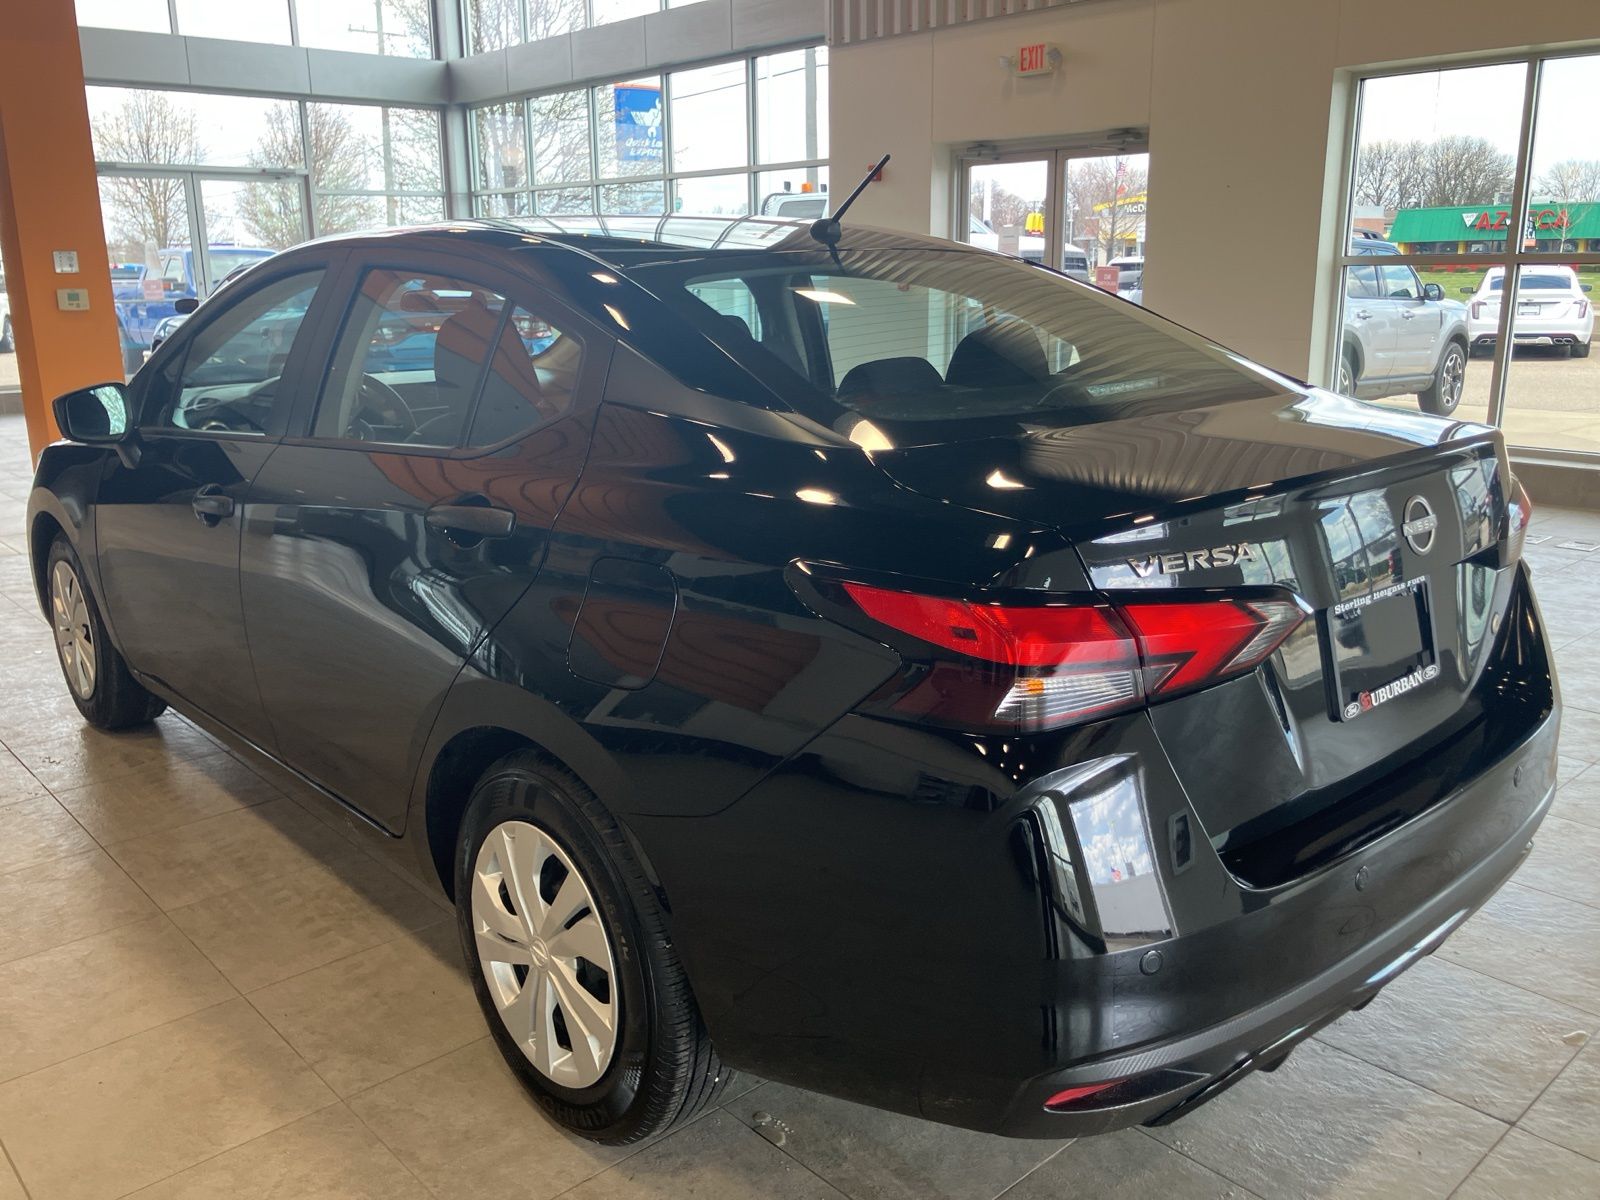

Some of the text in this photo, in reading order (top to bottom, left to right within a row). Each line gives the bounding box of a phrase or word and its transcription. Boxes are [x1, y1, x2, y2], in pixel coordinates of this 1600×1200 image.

[1020, 43, 1046, 72] EXIT
[1125, 203, 1146, 213] McD
[1475, 208, 1570, 231] AZCA
[1126, 542, 1257, 578] VERSA
[1334, 594, 1372, 614] Sterling
[1360, 670, 1424, 712] SUBURBAN
